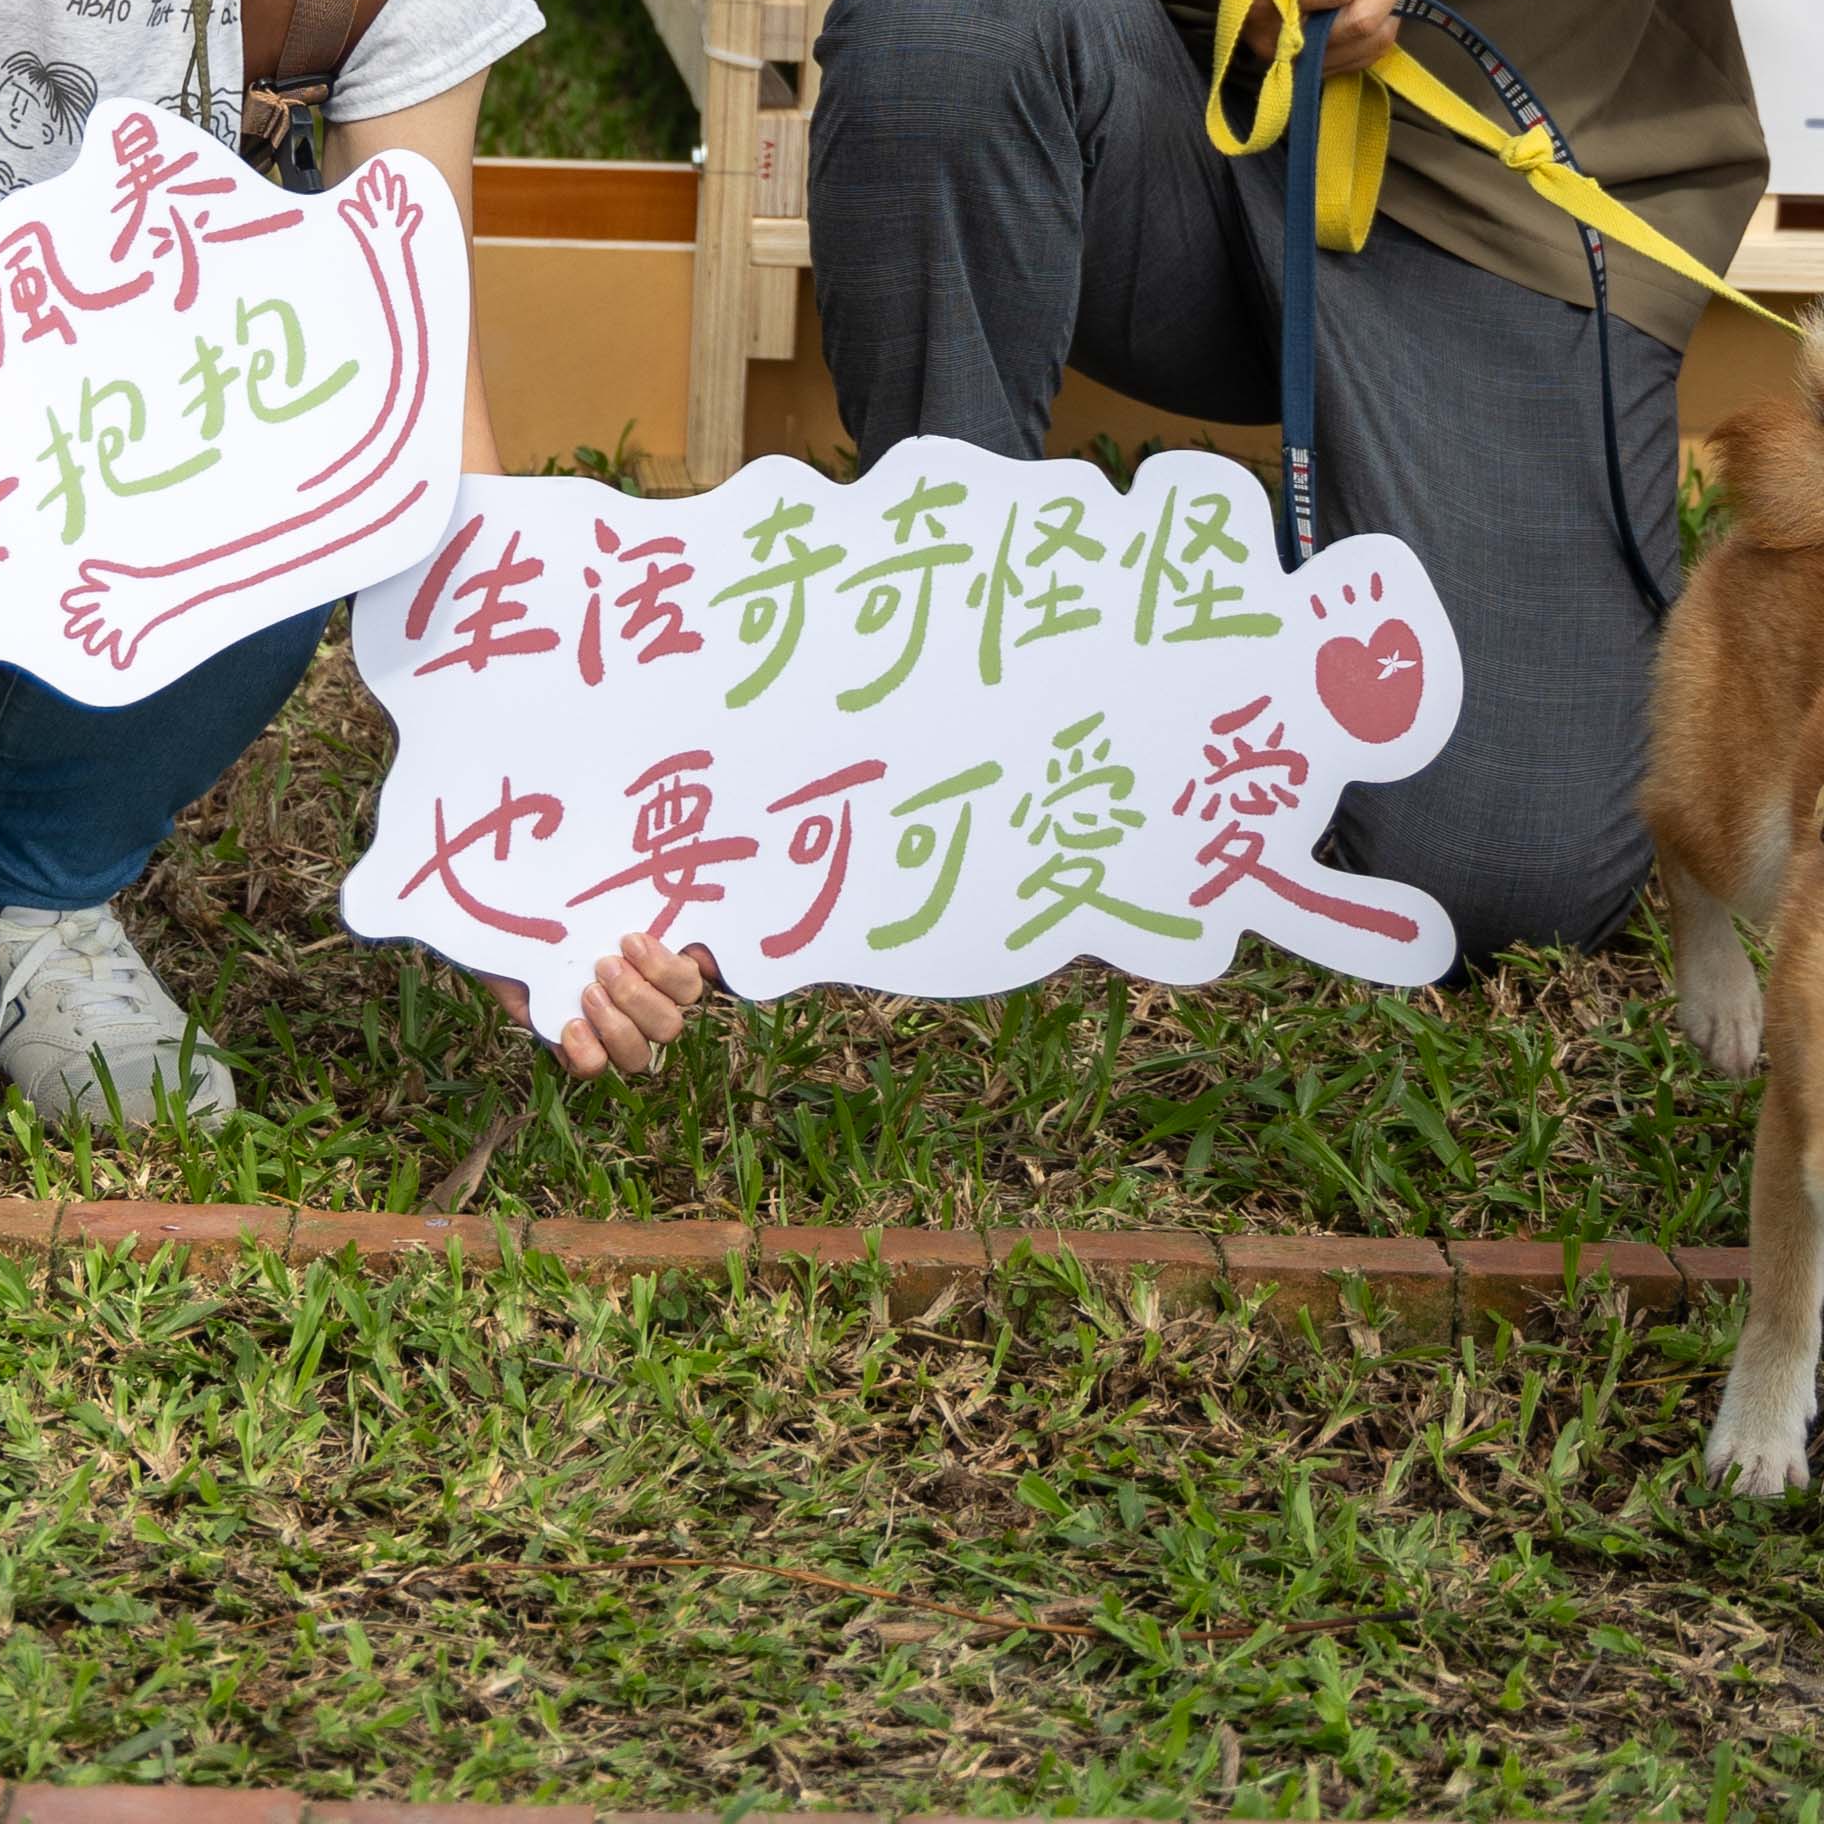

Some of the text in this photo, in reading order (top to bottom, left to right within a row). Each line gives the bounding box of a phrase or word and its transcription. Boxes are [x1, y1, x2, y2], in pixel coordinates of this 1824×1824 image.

[406, 477, 1282, 713] 生活奇奇怪怪
[398, 696, 1419, 960] 也要可可愛愛
